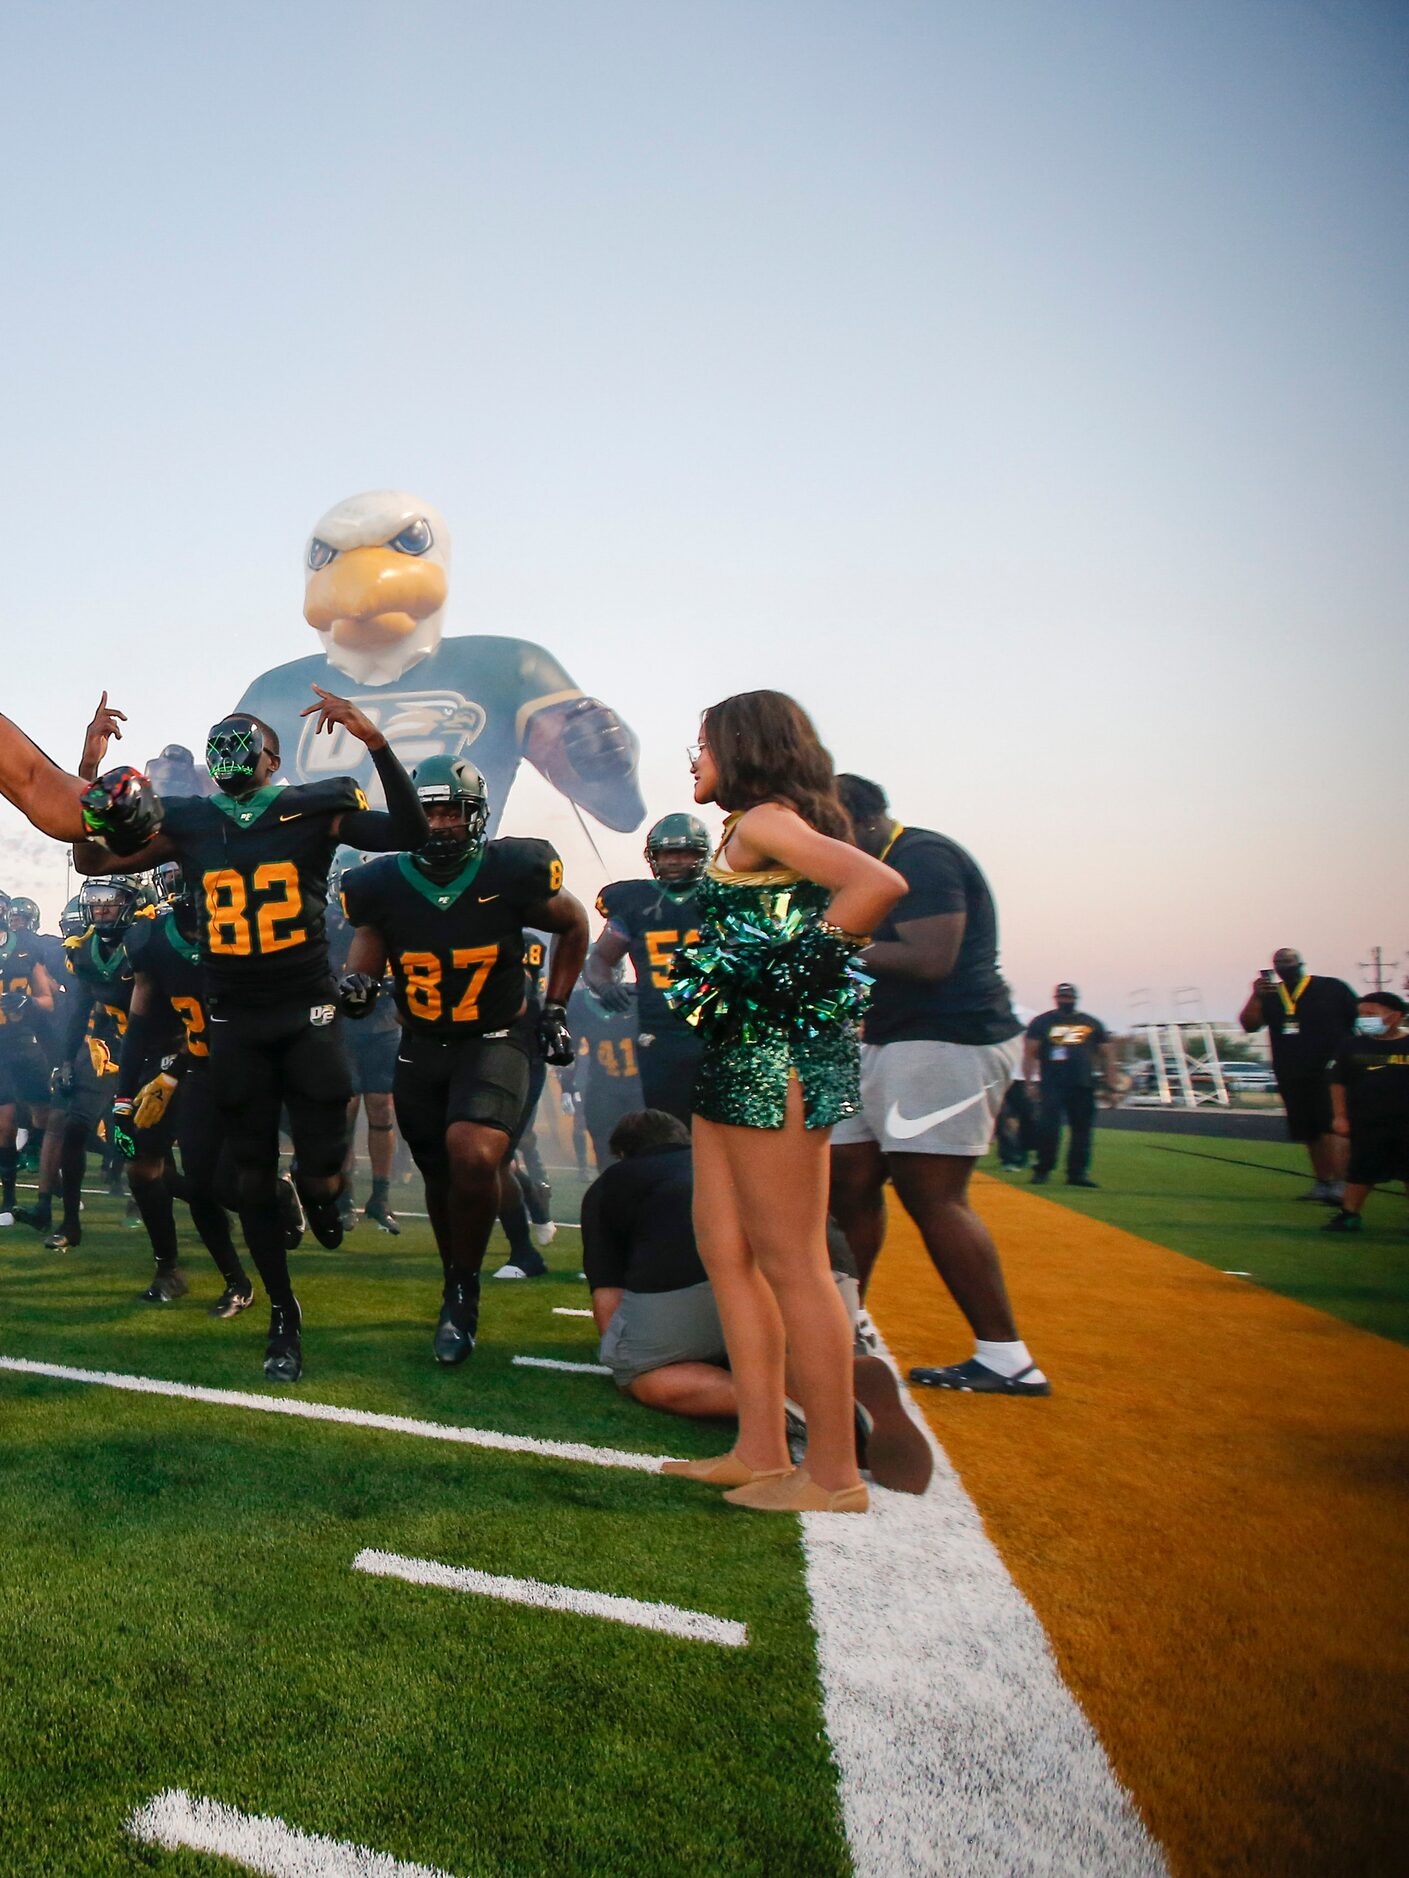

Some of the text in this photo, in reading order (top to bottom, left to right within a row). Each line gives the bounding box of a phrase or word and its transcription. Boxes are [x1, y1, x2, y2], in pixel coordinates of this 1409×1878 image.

[203, 860, 307, 956] 82
[398, 943, 499, 1023] 87
[644, 929, 701, 990] 5
